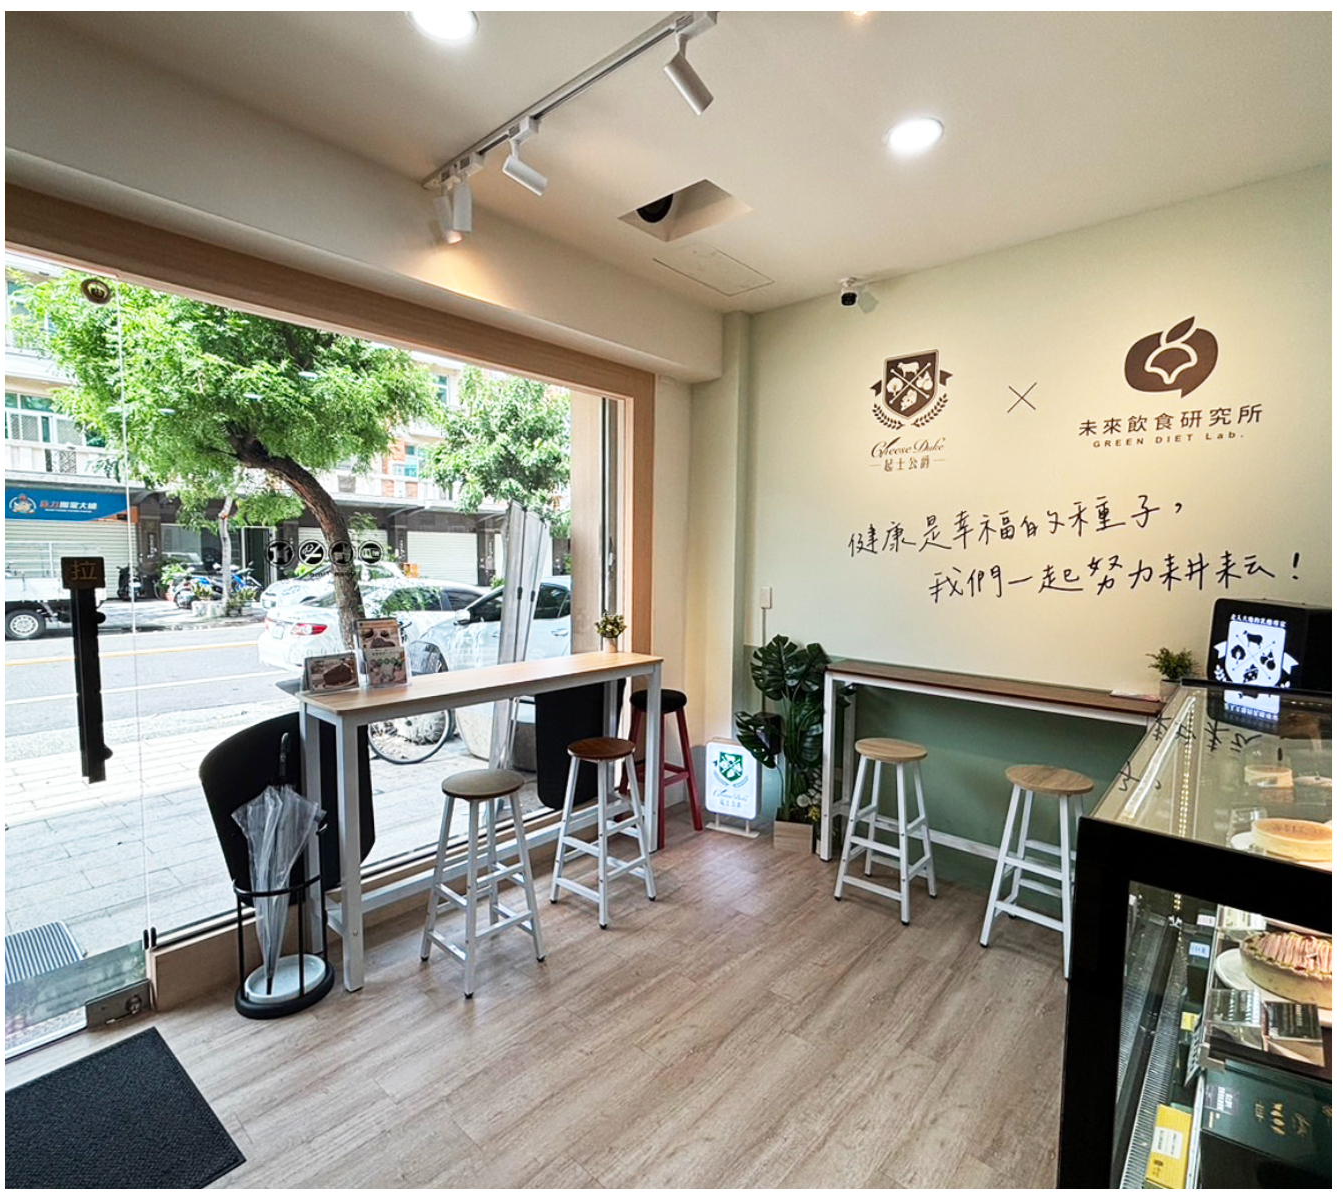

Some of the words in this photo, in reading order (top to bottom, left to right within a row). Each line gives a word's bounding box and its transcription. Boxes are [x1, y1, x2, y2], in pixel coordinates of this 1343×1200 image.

[1078, 403, 1263, 437] 未來飲食研究所
[871, 436, 912, 458] Cheese
[913, 437, 946, 454] Duke
[1092, 437, 1145, 449] GREEN
[1155, 433, 1194, 444] DIET
[70, 559, 98, 581] 拉
